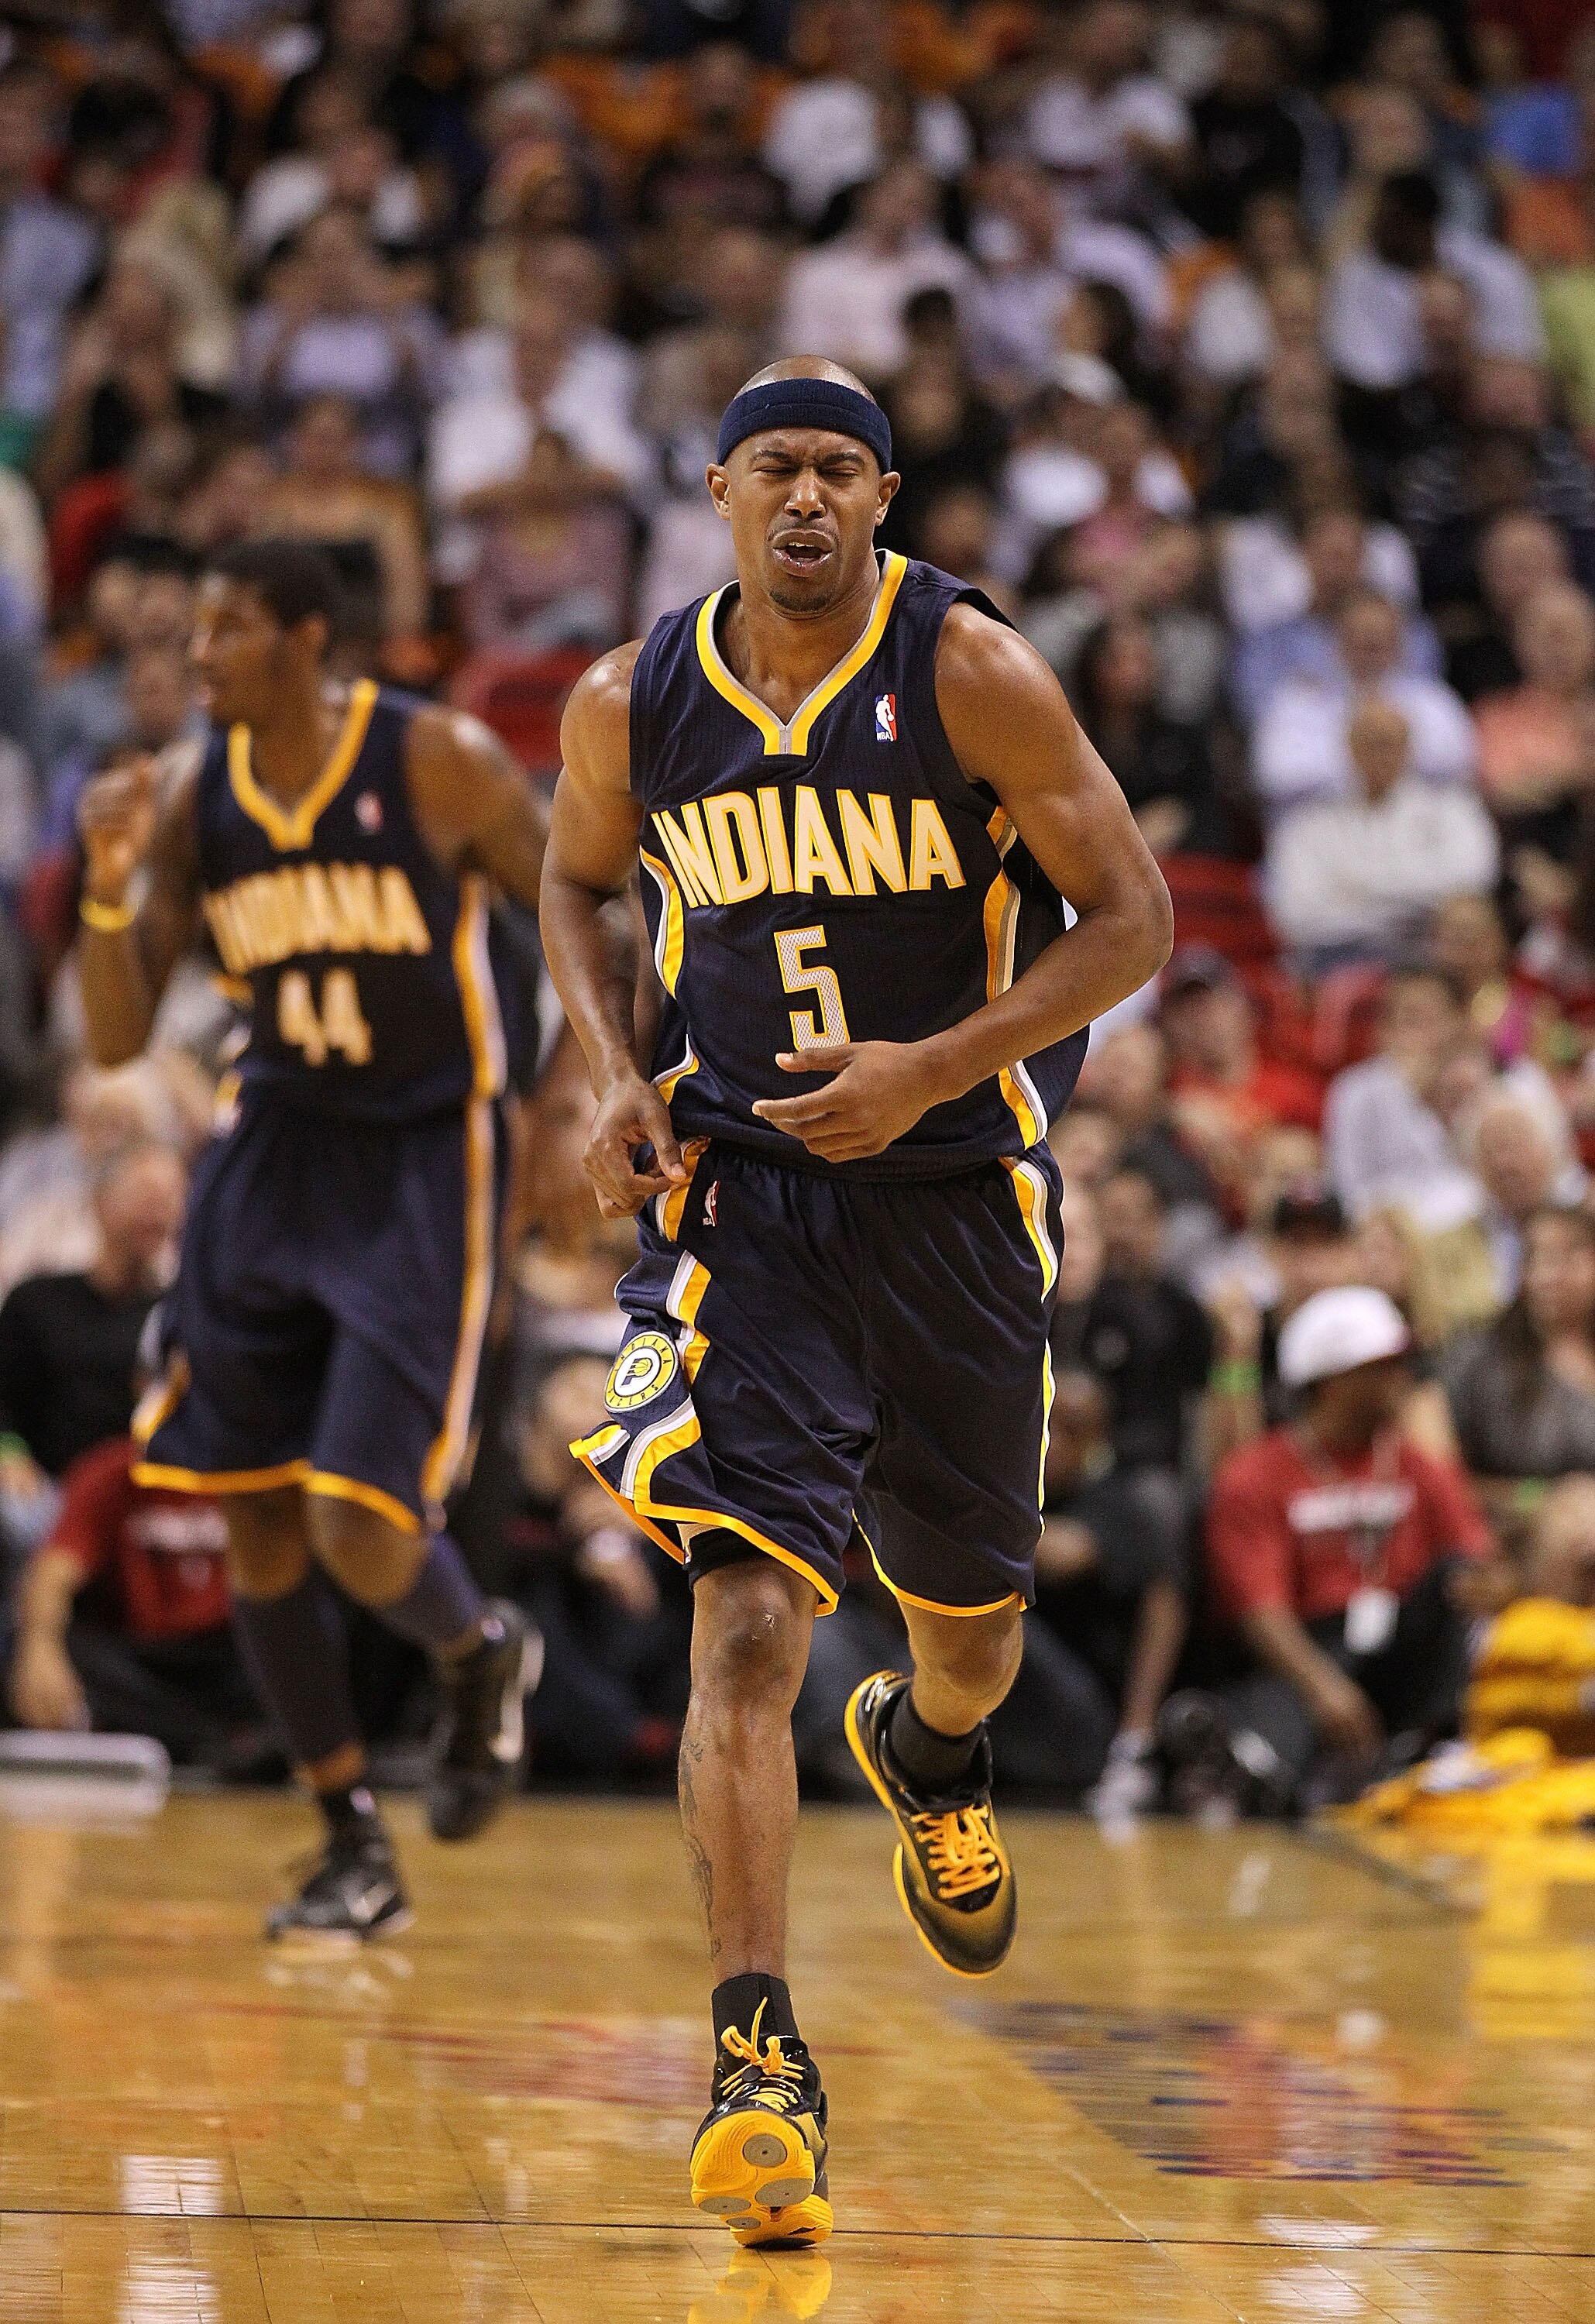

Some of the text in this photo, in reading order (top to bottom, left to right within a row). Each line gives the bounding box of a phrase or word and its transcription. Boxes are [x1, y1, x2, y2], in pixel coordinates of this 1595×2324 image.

[877, 731, 890, 741] NBA
[651, 786, 966, 909] INDIANA
[277, 966, 374, 1067] 44
[773, 925, 851, 1052] 5
